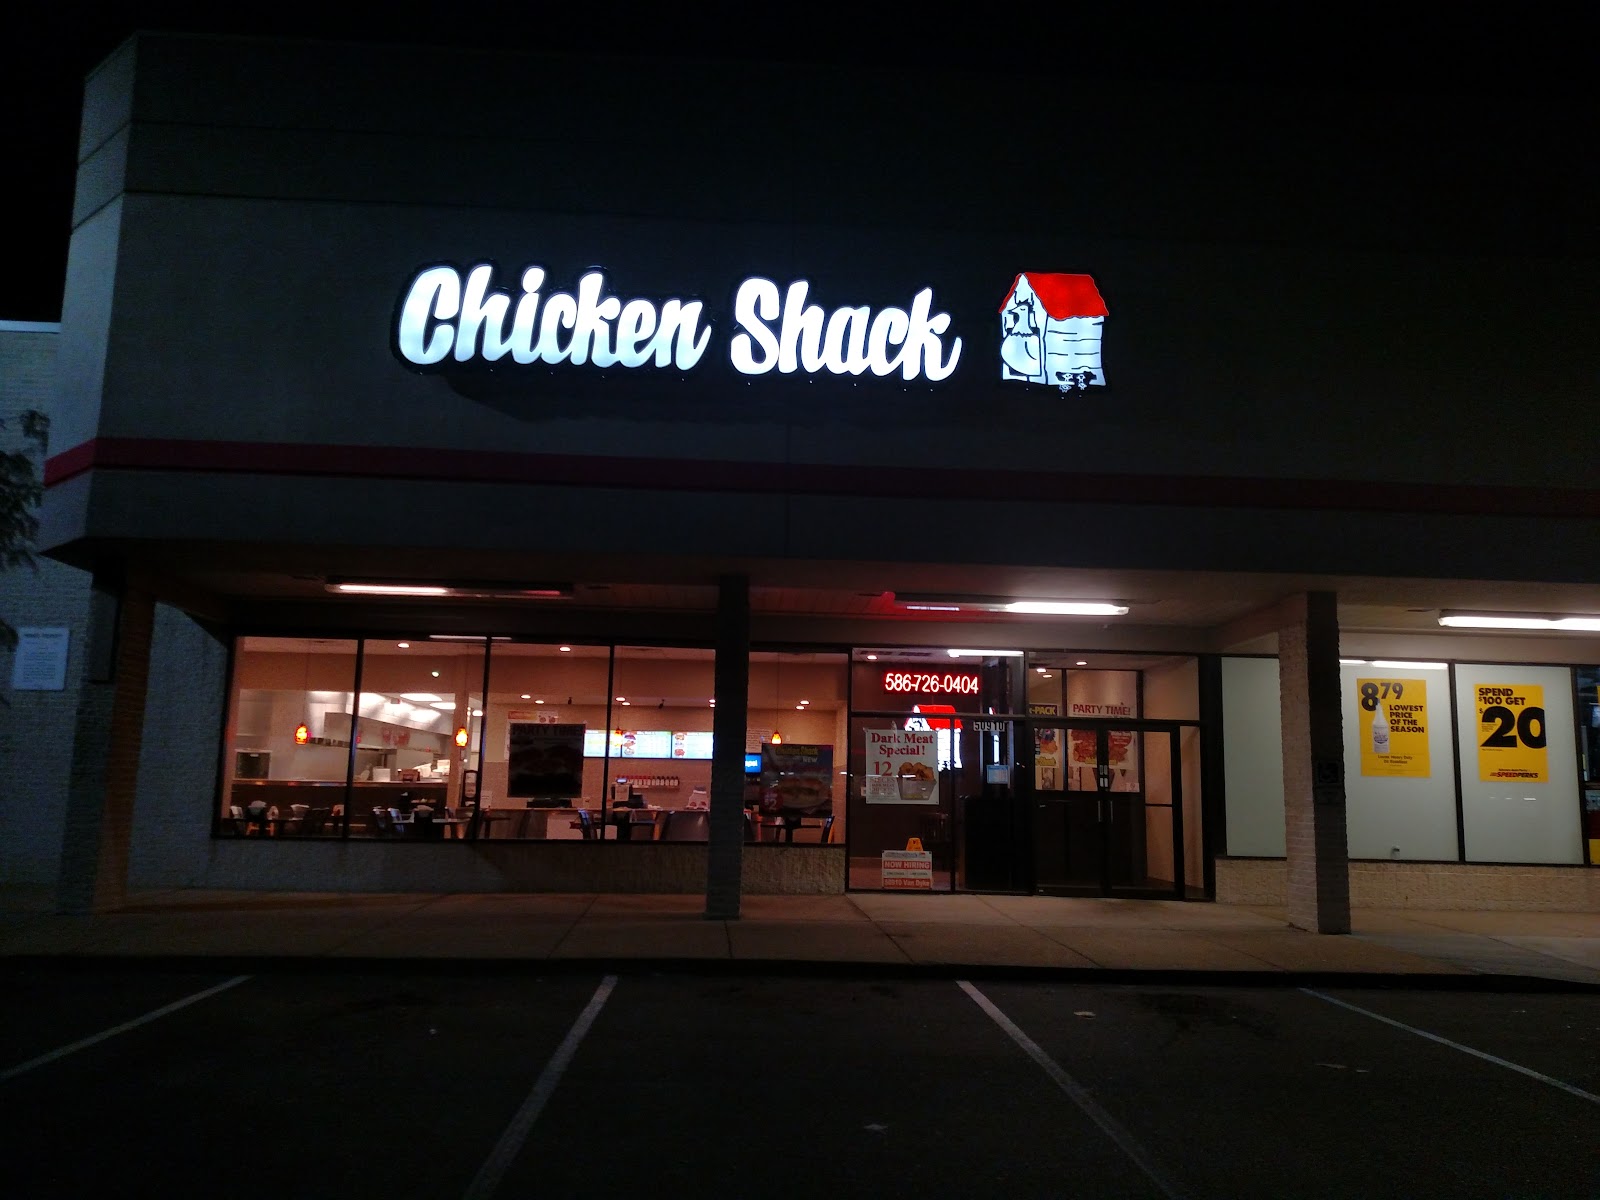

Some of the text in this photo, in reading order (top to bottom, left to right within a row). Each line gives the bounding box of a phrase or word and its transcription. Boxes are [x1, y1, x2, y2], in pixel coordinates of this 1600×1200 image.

[399, 263, 962, 382] Chicken Shack
[885, 673, 979, 694] 586-726-0404
[1478, 687, 1513, 697] SPEND
[1478, 696, 1526, 705] $100 GET
[1073, 703, 1131, 715] PARTY TIME!
[1389, 704, 1424, 712] LOWEST
[1389, 711, 1413, 719] PRICE
[974, 721, 1005, 731] 50910
[871, 732, 934, 744] Dark Meat
[873, 761, 893, 777] 12
[1496, 771, 1539, 779] SPEEDPERKS
[884, 861, 930, 869] NOW HIRING
[903, 879, 915, 887] Van
[915, 879, 930, 888] Dyke
